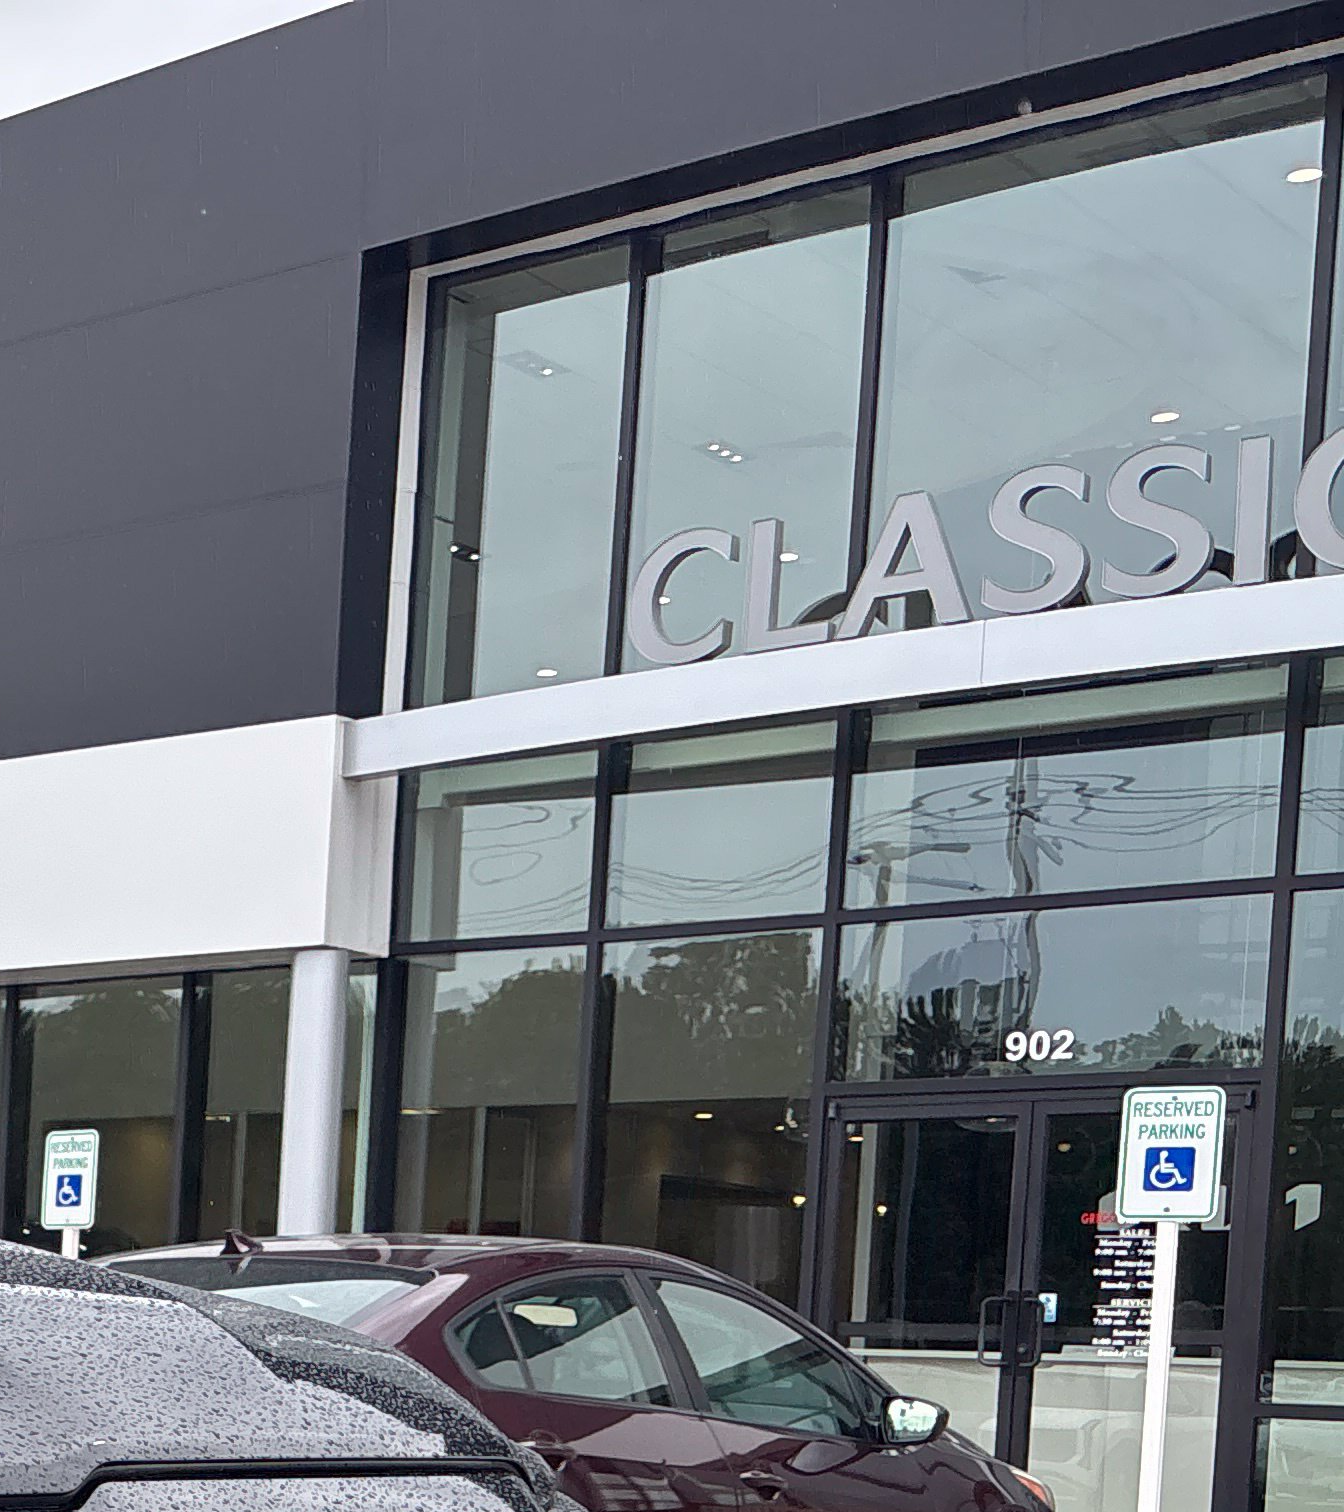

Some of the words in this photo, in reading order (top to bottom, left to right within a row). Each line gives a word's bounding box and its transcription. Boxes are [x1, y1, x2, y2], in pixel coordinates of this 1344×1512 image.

[1005, 1029, 1074, 1061] 902
[1133, 1101, 1215, 1117] RESERVED
[1138, 1124, 1206, 1140] PARKING
[50, 1141, 93, 1153] RESERVED
[53, 1157, 89, 1169] PARKING
[1099, 1239, 1132, 1248] Monday
[1114, 1260, 1152, 1268] Saturday
[1100, 1281, 1131, 1290] Sunday
[1097, 1309, 1130, 1318] Monday
[1097, 1350, 1127, 1358] Sunday
